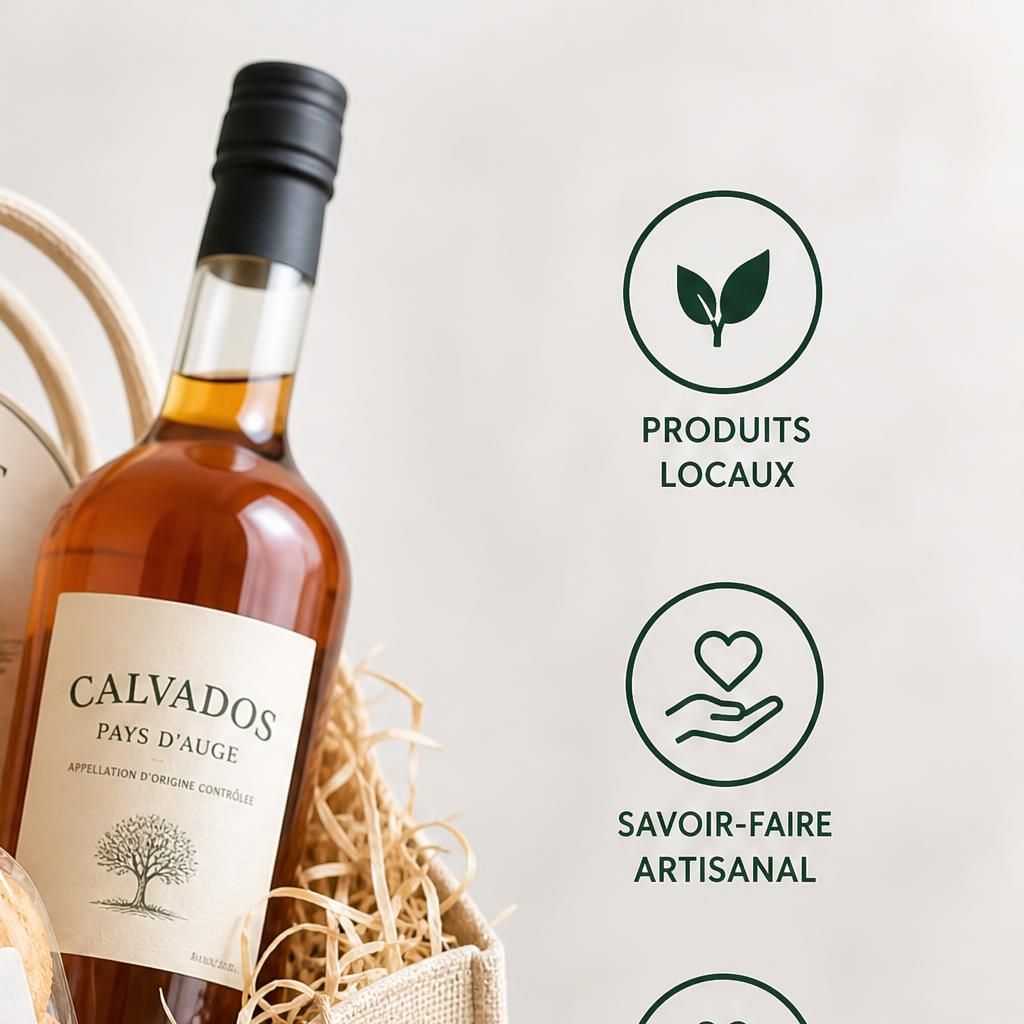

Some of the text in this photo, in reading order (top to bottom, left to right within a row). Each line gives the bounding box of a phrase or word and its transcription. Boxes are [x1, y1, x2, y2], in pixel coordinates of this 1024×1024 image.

[69, 672, 276, 742] CALVADOS
[96, 722, 239, 764] PAYS D'AUGE
[68, 762, 137, 780] APPELLATION
[140, 771, 195, 791] D'ORIGINE
